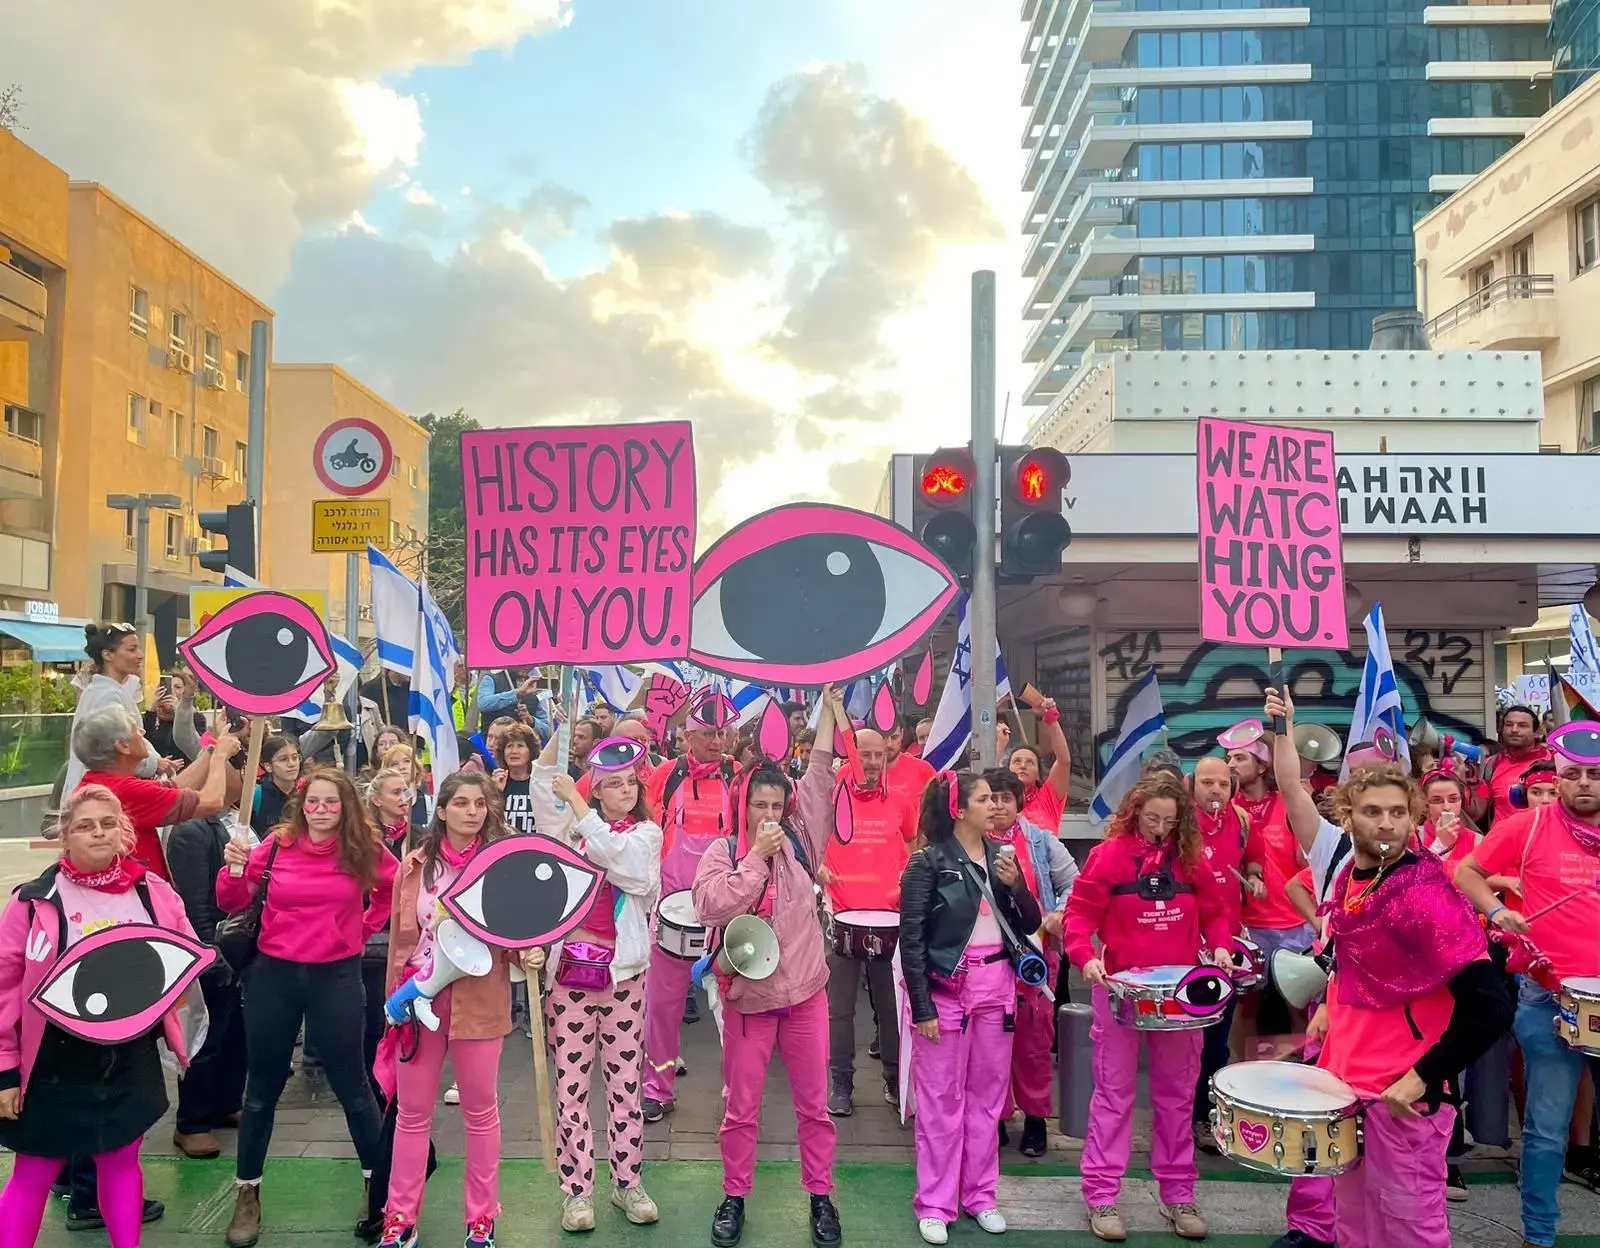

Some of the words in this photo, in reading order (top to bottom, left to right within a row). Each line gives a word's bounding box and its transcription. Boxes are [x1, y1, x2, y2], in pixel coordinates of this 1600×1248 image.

[471, 437, 685, 515] HISTORY
[1205, 424, 1256, 478] WE
[1260, 436, 1328, 483] ARE
[323, 506, 348, 517] לרכב
[331, 521, 358, 531] גלגלי
[350, 507, 380, 517] החניה
[1206, 481, 1332, 539] WATC
[1364, 497, 1487, 524] WAAH
[317, 535, 349, 545] אסורה
[474, 526, 539, 577] HAS
[548, 526, 608, 574] ITS
[619, 525, 689, 573] EYES
[1205, 536, 1336, 592] HING
[489, 586, 562, 654] ON
[571, 585, 681, 650] YOU.
[1211, 588, 1334, 642] YOU.
